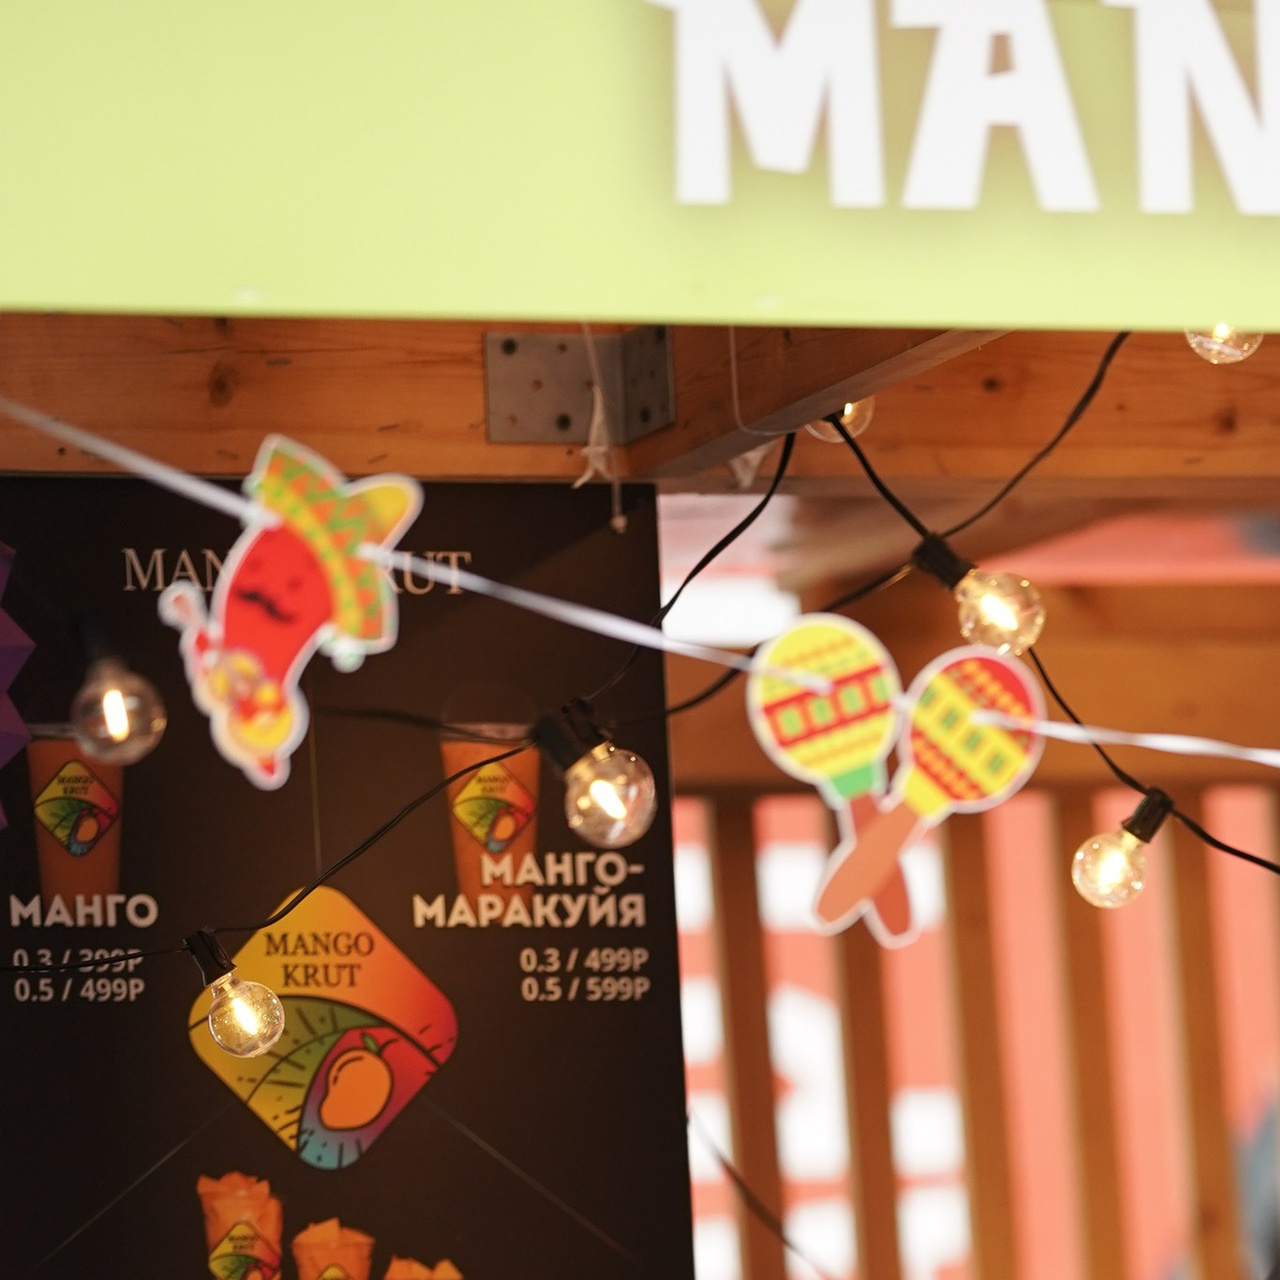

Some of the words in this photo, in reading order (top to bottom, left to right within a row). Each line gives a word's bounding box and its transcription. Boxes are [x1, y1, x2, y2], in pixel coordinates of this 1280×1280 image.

[121, 547, 226, 592] MAN
[480, 852, 645, 887] МАНГО-
[9, 893, 159, 928] МАНГО
[412, 886, 648, 928] МАРАКУЙЯ
[264, 931, 375, 957] MANGO
[13, 948, 53, 973] 03
[519, 947, 562, 973] 0.3
[282, 963, 362, 988] KRUT
[14, 977, 55, 1002] 0.5
[521, 976, 563, 1002] 0.5
